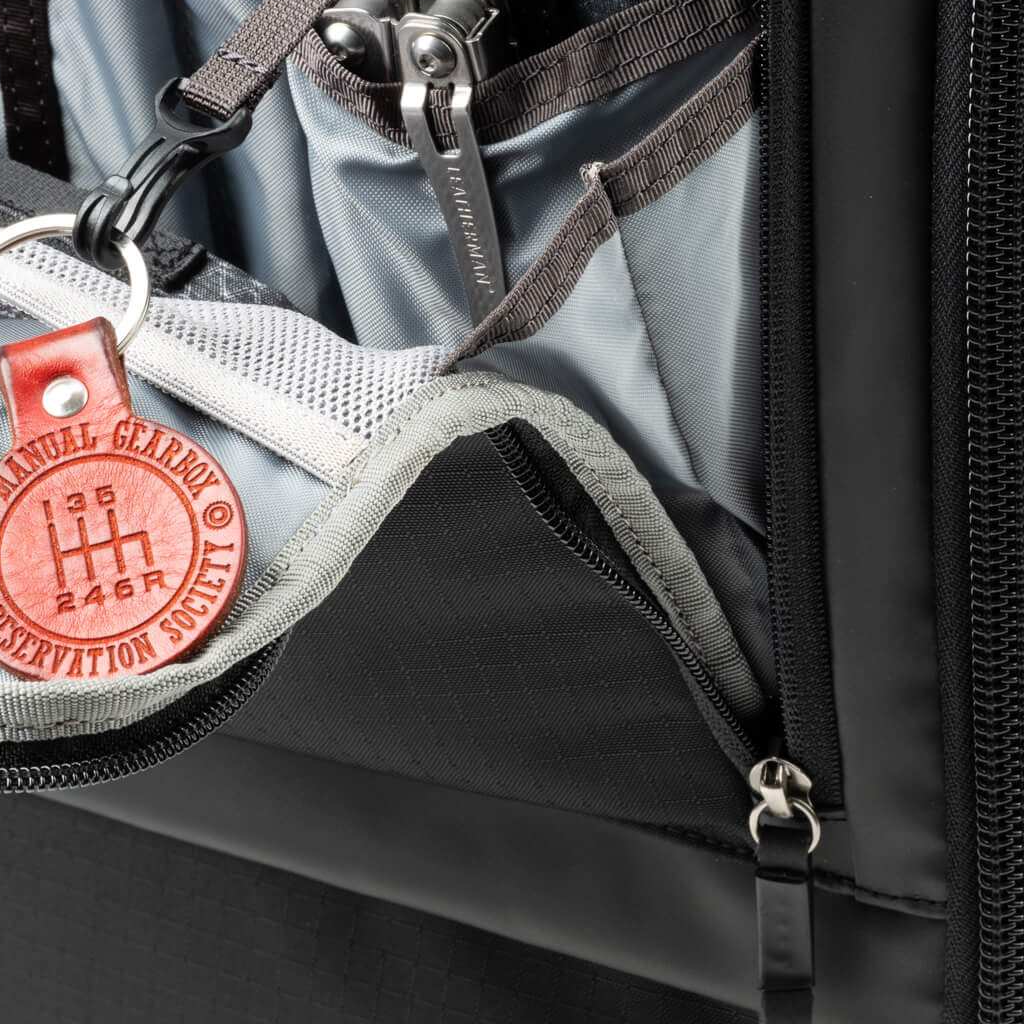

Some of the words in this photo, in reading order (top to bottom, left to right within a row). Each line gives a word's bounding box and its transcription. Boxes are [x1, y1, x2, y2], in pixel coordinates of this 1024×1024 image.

[447, 167, 492, 285] LEATHERMAN
[113, 419, 222, 500] GEARBOX
[160, 539, 235, 644] SOCIETY
